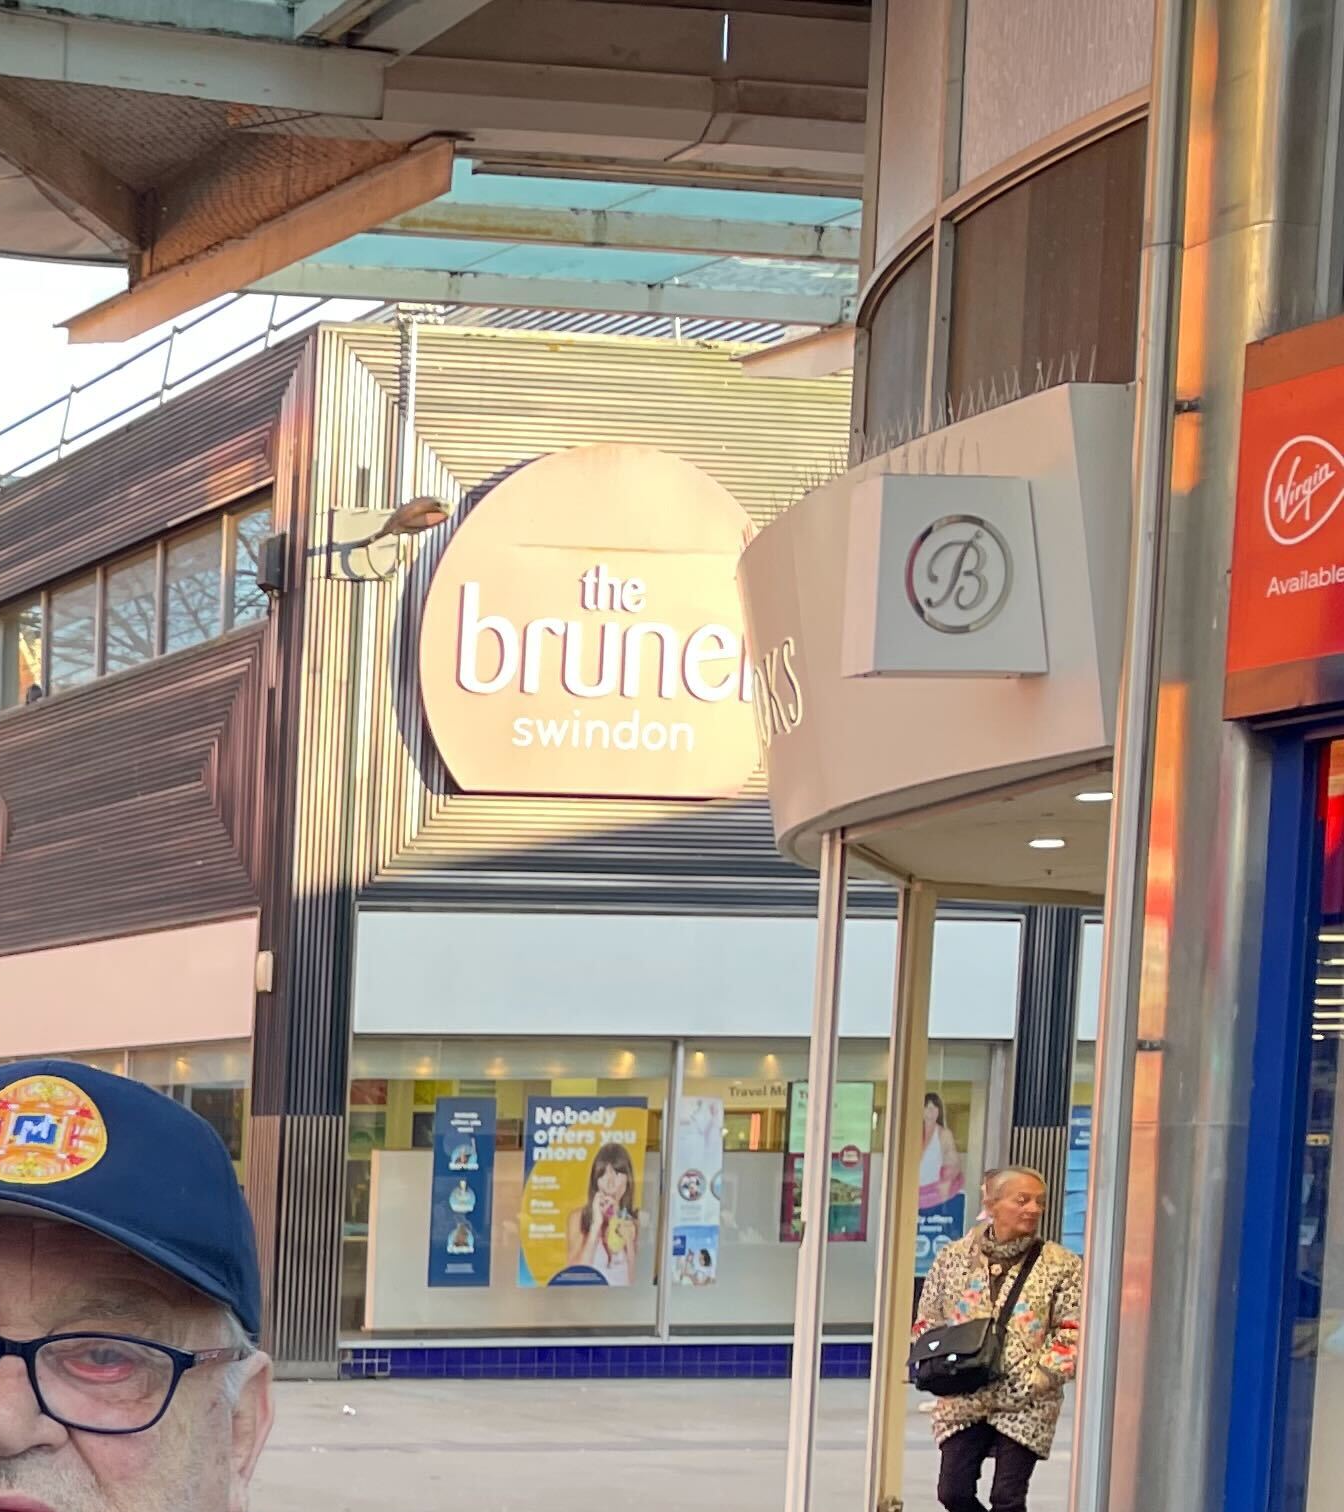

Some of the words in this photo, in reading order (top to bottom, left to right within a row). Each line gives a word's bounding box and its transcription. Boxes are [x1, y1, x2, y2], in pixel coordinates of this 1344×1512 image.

[1274, 455, 1337, 524] Virgin
[579, 563, 647, 614] the
[752, 636, 803, 752] OKS
[511, 708, 695, 752] swindon
[728, 1084, 767, 1097] Travel
[534, 1106, 617, 1127] Nobody
[533, 1126, 597, 1144] offers
[601, 1129, 638, 1146] you
[533, 1146, 588, 1161] more
